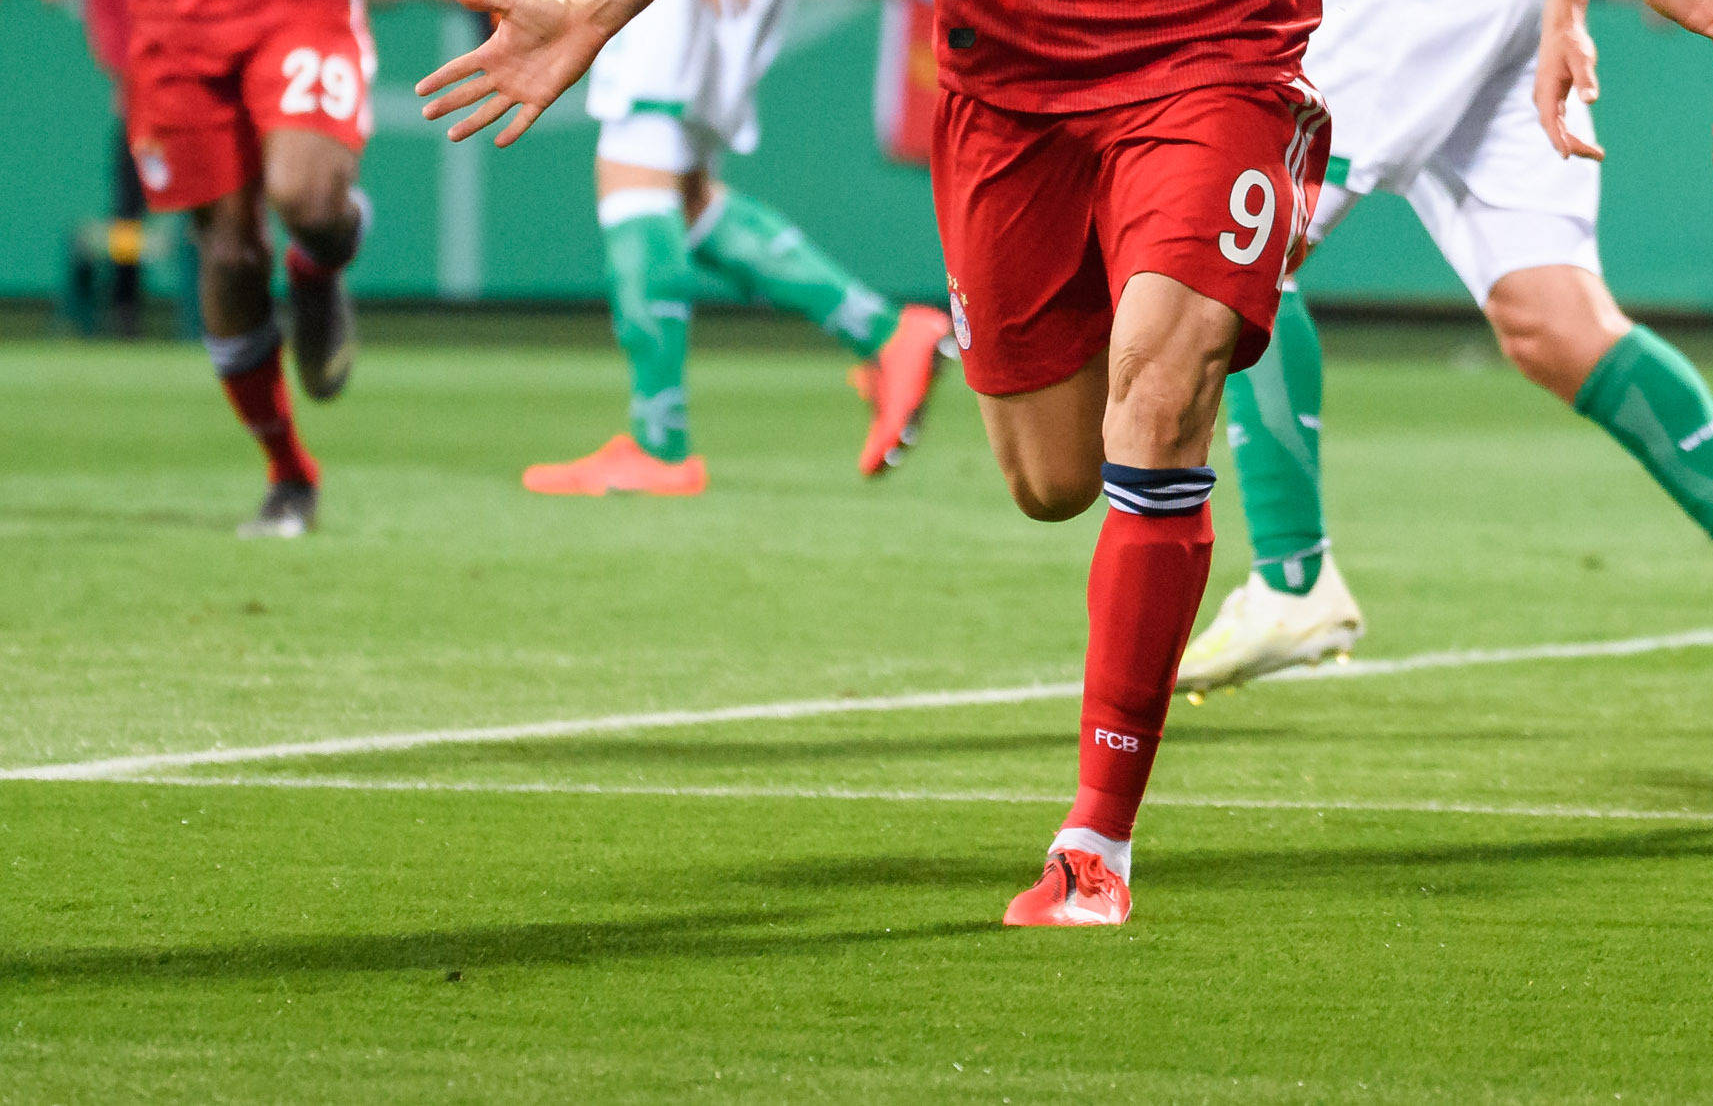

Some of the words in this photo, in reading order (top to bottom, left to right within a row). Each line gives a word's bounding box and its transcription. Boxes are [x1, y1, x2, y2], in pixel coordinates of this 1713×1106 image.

[280, 48, 359, 122] 29
[1219, 169, 1276, 265] 9
[1095, 728, 1139, 752] FCB
